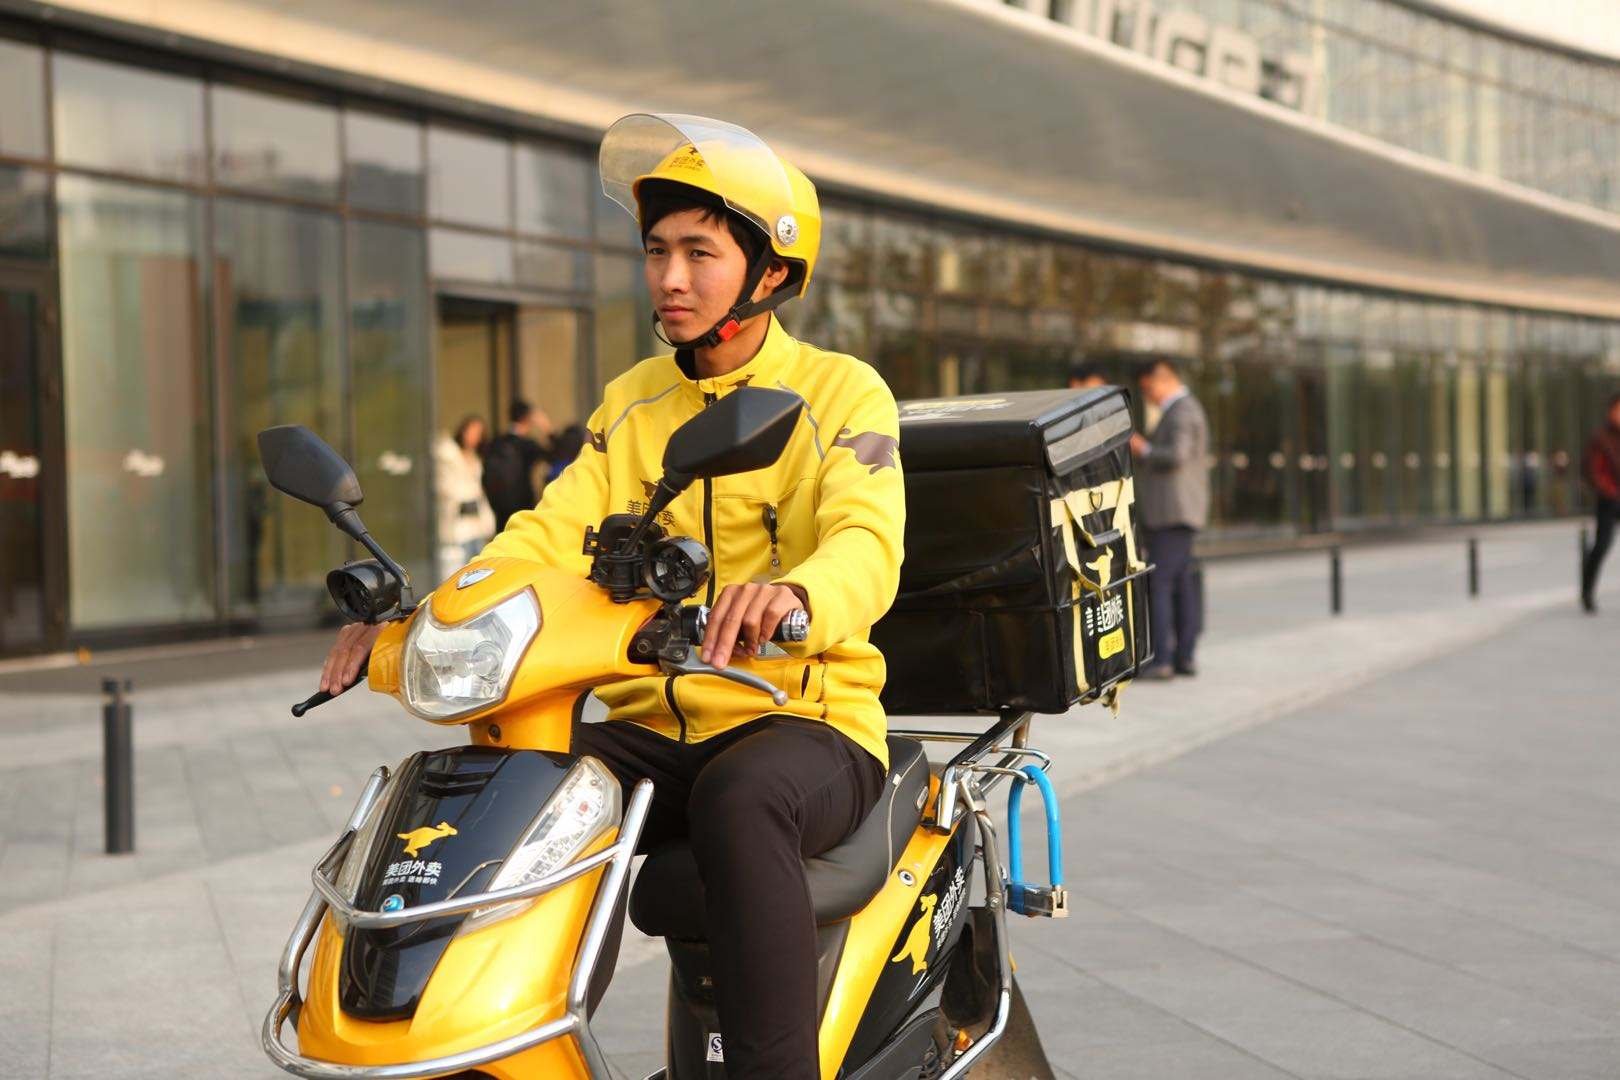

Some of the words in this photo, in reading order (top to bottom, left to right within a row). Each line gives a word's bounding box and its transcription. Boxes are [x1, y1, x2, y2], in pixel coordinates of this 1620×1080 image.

[384, 860, 442, 878] 美团外卖
[932, 866, 965, 940] 美团外卖
